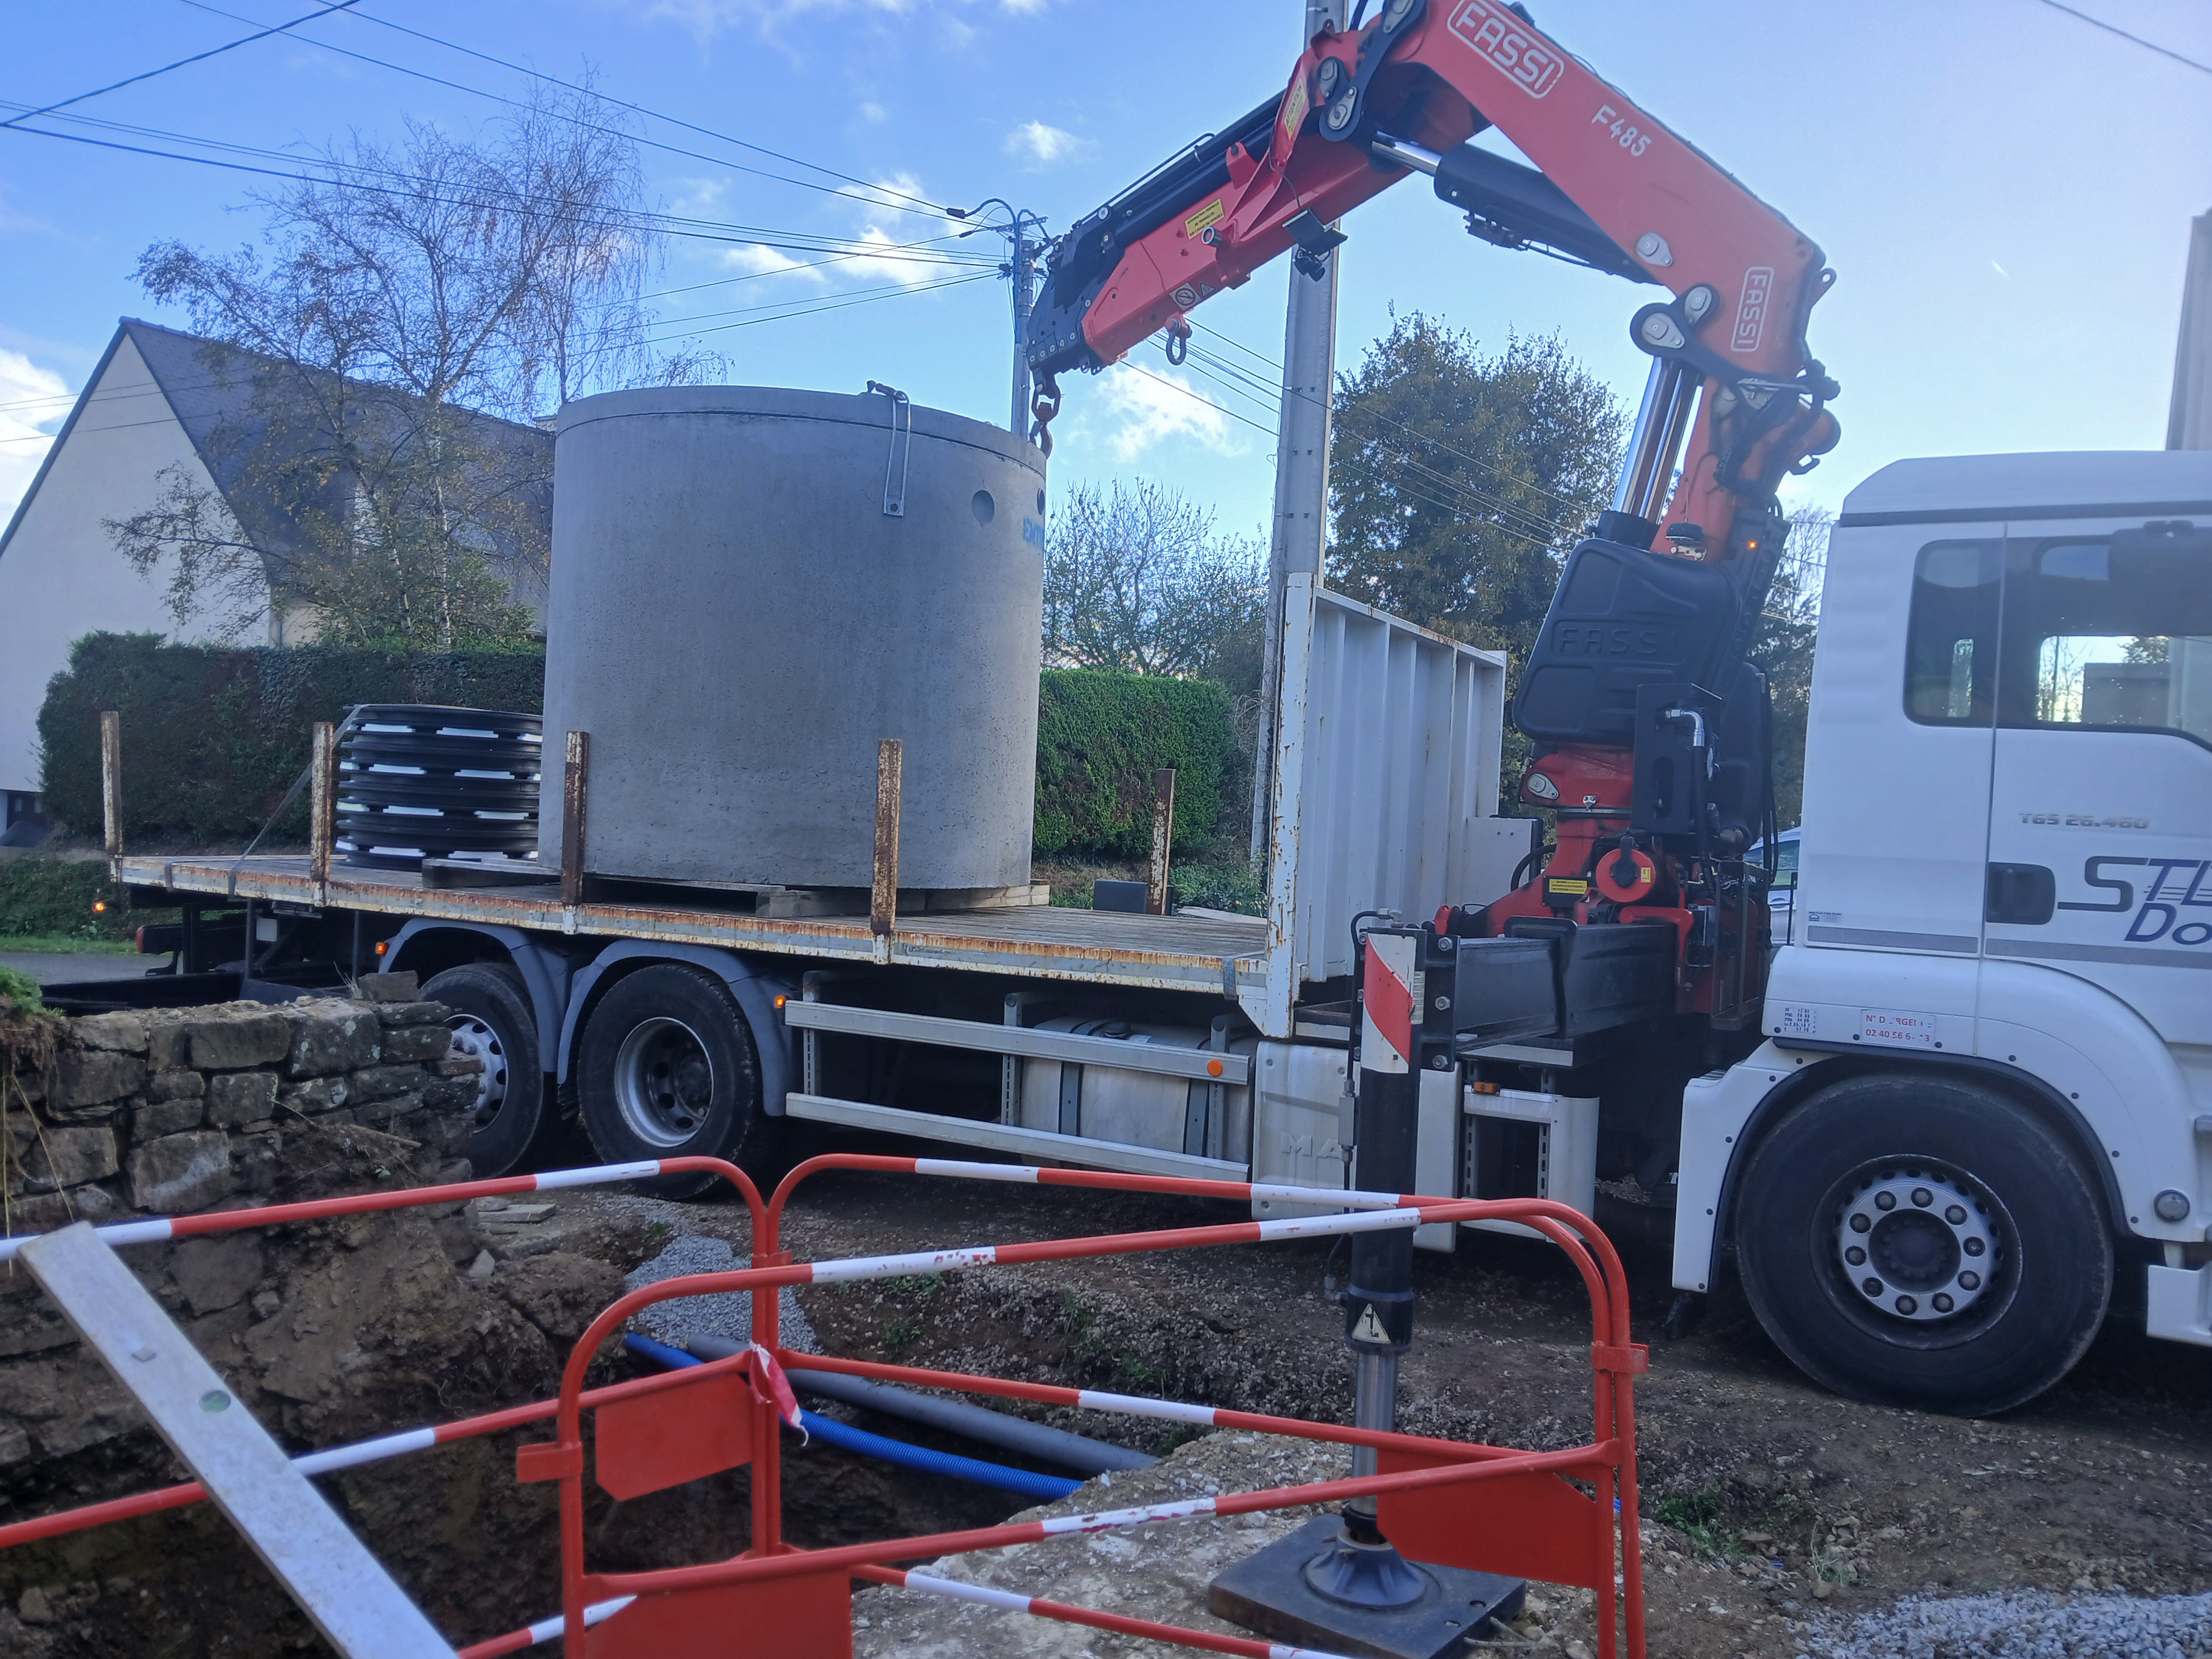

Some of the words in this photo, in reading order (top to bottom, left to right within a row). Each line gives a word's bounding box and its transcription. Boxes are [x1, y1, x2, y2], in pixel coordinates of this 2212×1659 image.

[1455, 2, 1557, 90] FASSI
[1591, 104, 1652, 157] F485
[1737, 273, 1768, 347] FASSI
[2018, 811, 2060, 825] TGS
[2066, 814, 2149, 829] 26.460
[2057, 855, 2212, 913] STL
[1866, 1028, 1877, 1037] 02
[1879, 1029, 1890, 1038] 40
[1905, 1032, 1915, 1040] 6
[1281, 1131, 1341, 1159] MA
